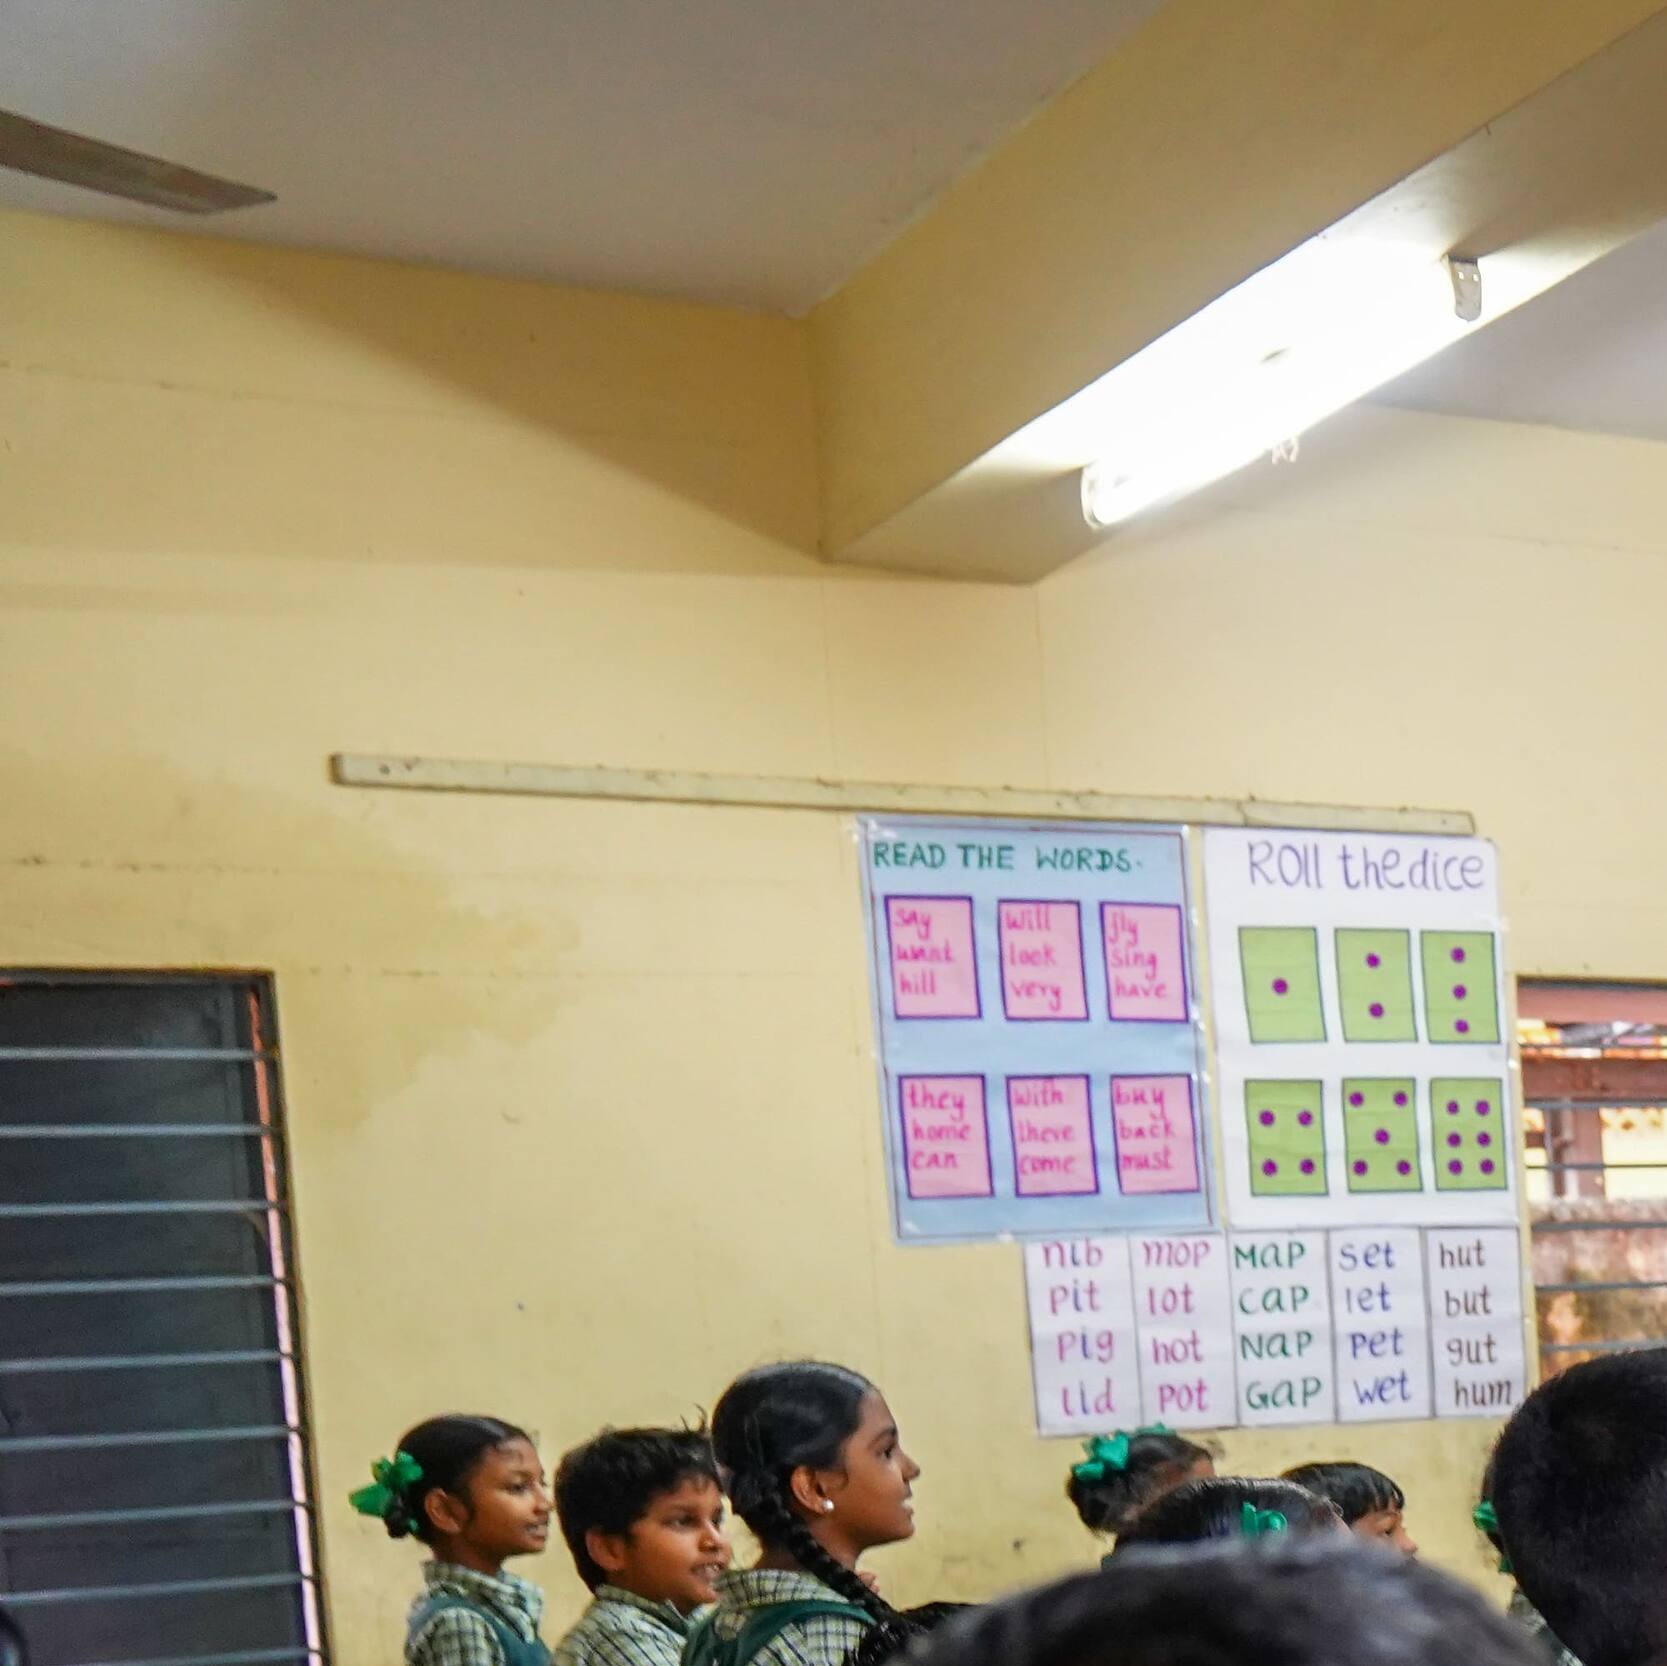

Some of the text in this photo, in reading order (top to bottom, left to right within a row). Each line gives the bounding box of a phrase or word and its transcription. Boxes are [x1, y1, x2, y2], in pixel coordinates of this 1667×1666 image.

[873, 841, 946, 868] READ
[956, 843, 1015, 870] THE
[1114, 977, 1167, 999] have
[908, 1082, 965, 1122] they
[1114, 1083, 1167, 1120] buy
[911, 1117, 972, 1142] home
[1118, 1115, 1176, 1140] back
[1121, 1145, 1174, 1172] must
[1041, 1238, 1104, 1269] nib
[1142, 1239, 1212, 1269] mop
[1439, 1238, 1486, 1269] hut
[1444, 1285, 1492, 1317] but
[1152, 1328, 1204, 1365] hot
[1446, 1333, 1498, 1367] gut
[1453, 1379, 1513, 1409] hum
